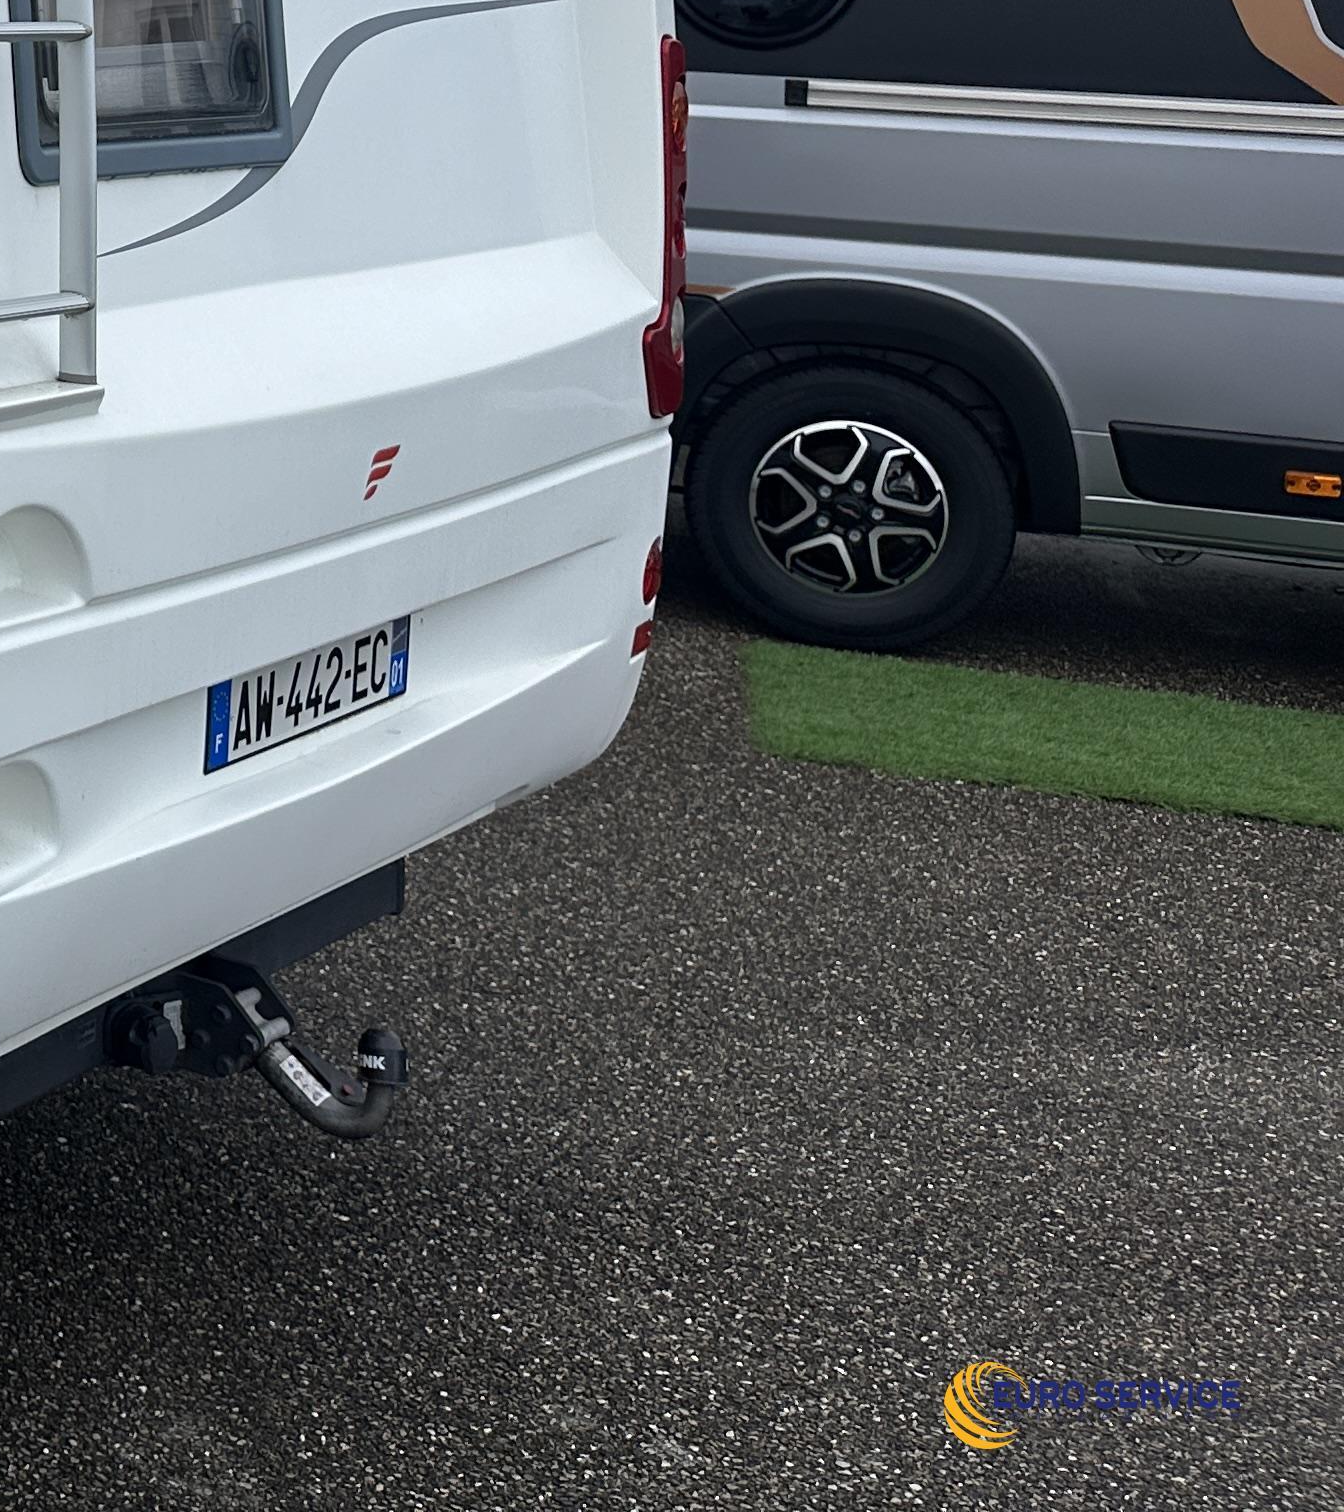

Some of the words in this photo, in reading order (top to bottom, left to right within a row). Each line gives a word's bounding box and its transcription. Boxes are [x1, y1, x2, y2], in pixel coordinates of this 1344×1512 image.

[214, 733, 224, 754] F
[231, 629, 388, 750] AW-442-EC
[390, 657, 404, 687] 01
